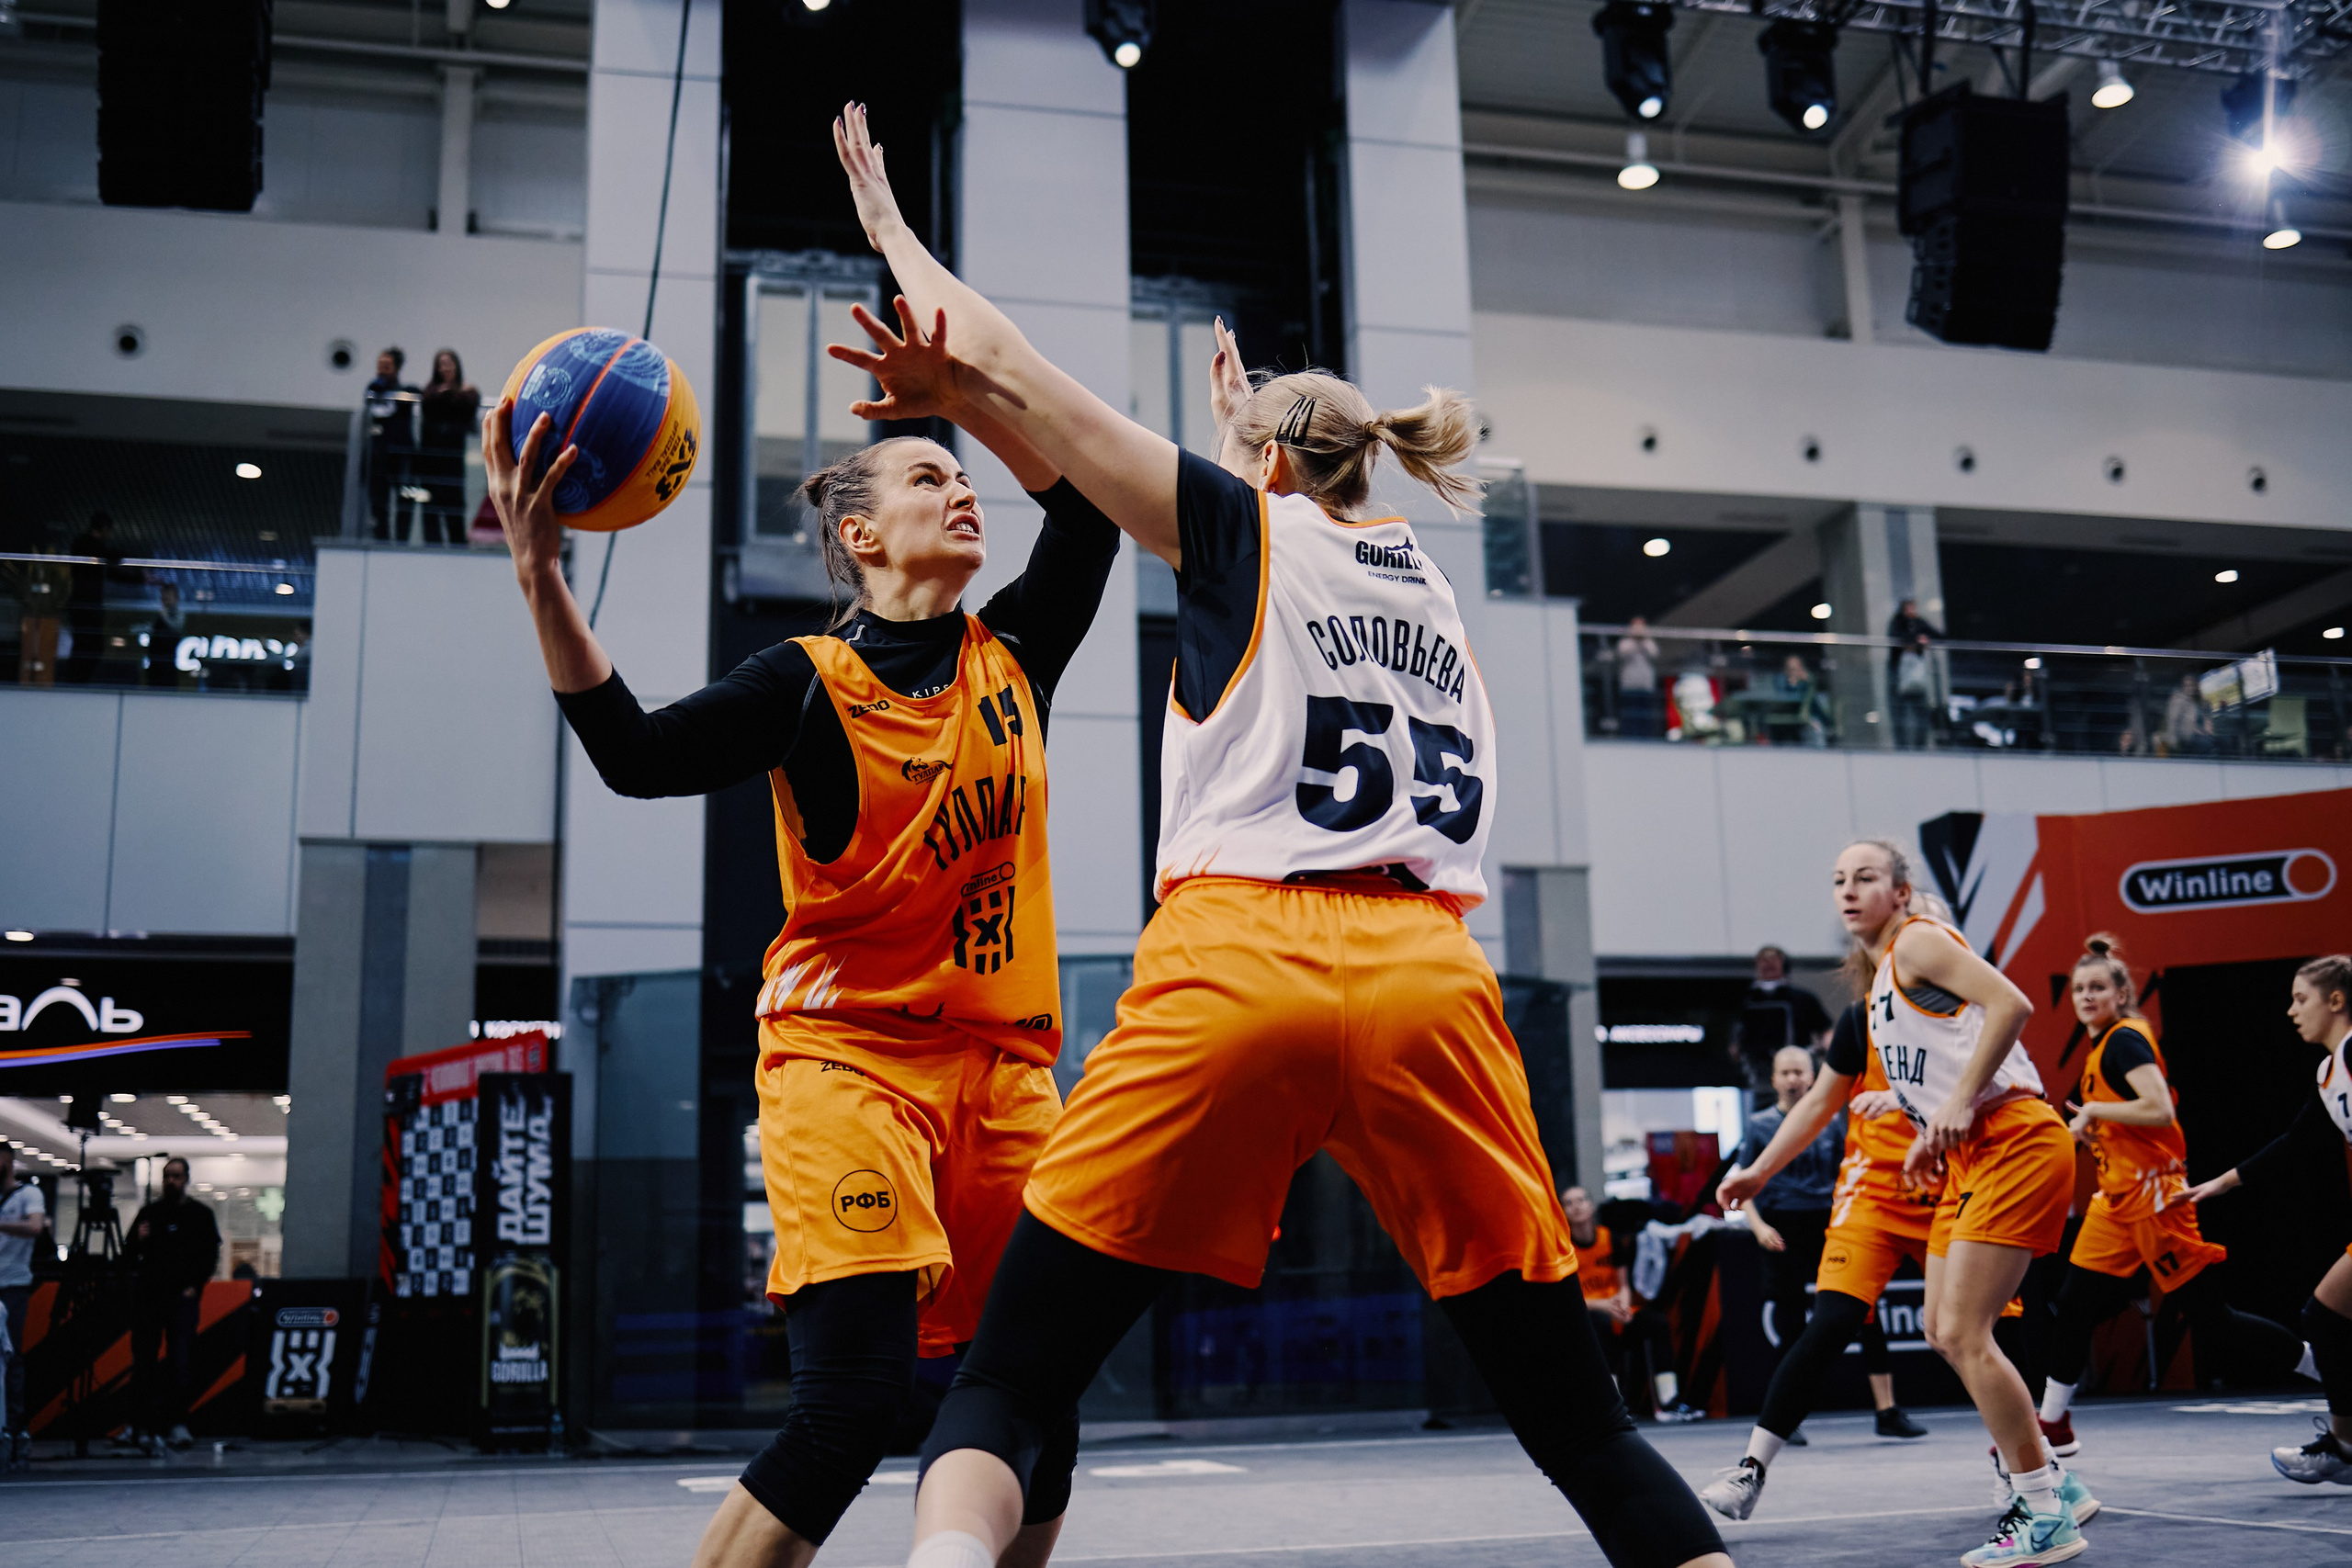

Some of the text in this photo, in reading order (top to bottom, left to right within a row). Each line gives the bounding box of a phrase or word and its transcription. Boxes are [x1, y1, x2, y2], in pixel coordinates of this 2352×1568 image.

[645, 420, 679, 478] OFFICIAL BALL
[1368, 570, 1427, 586] ENERGY DRINK
[1306, 615, 1465, 705] СОЛОВЬЕВА
[978, 683, 1023, 747] 15
[911, 763, 944, 783] ТУЛПАР
[1295, 694, 1484, 845] 55
[2137, 867, 2274, 902] Winline
[491, 1093, 526, 1240] ДАЙТЕ
[840, 1191, 891, 1213] РФБ
